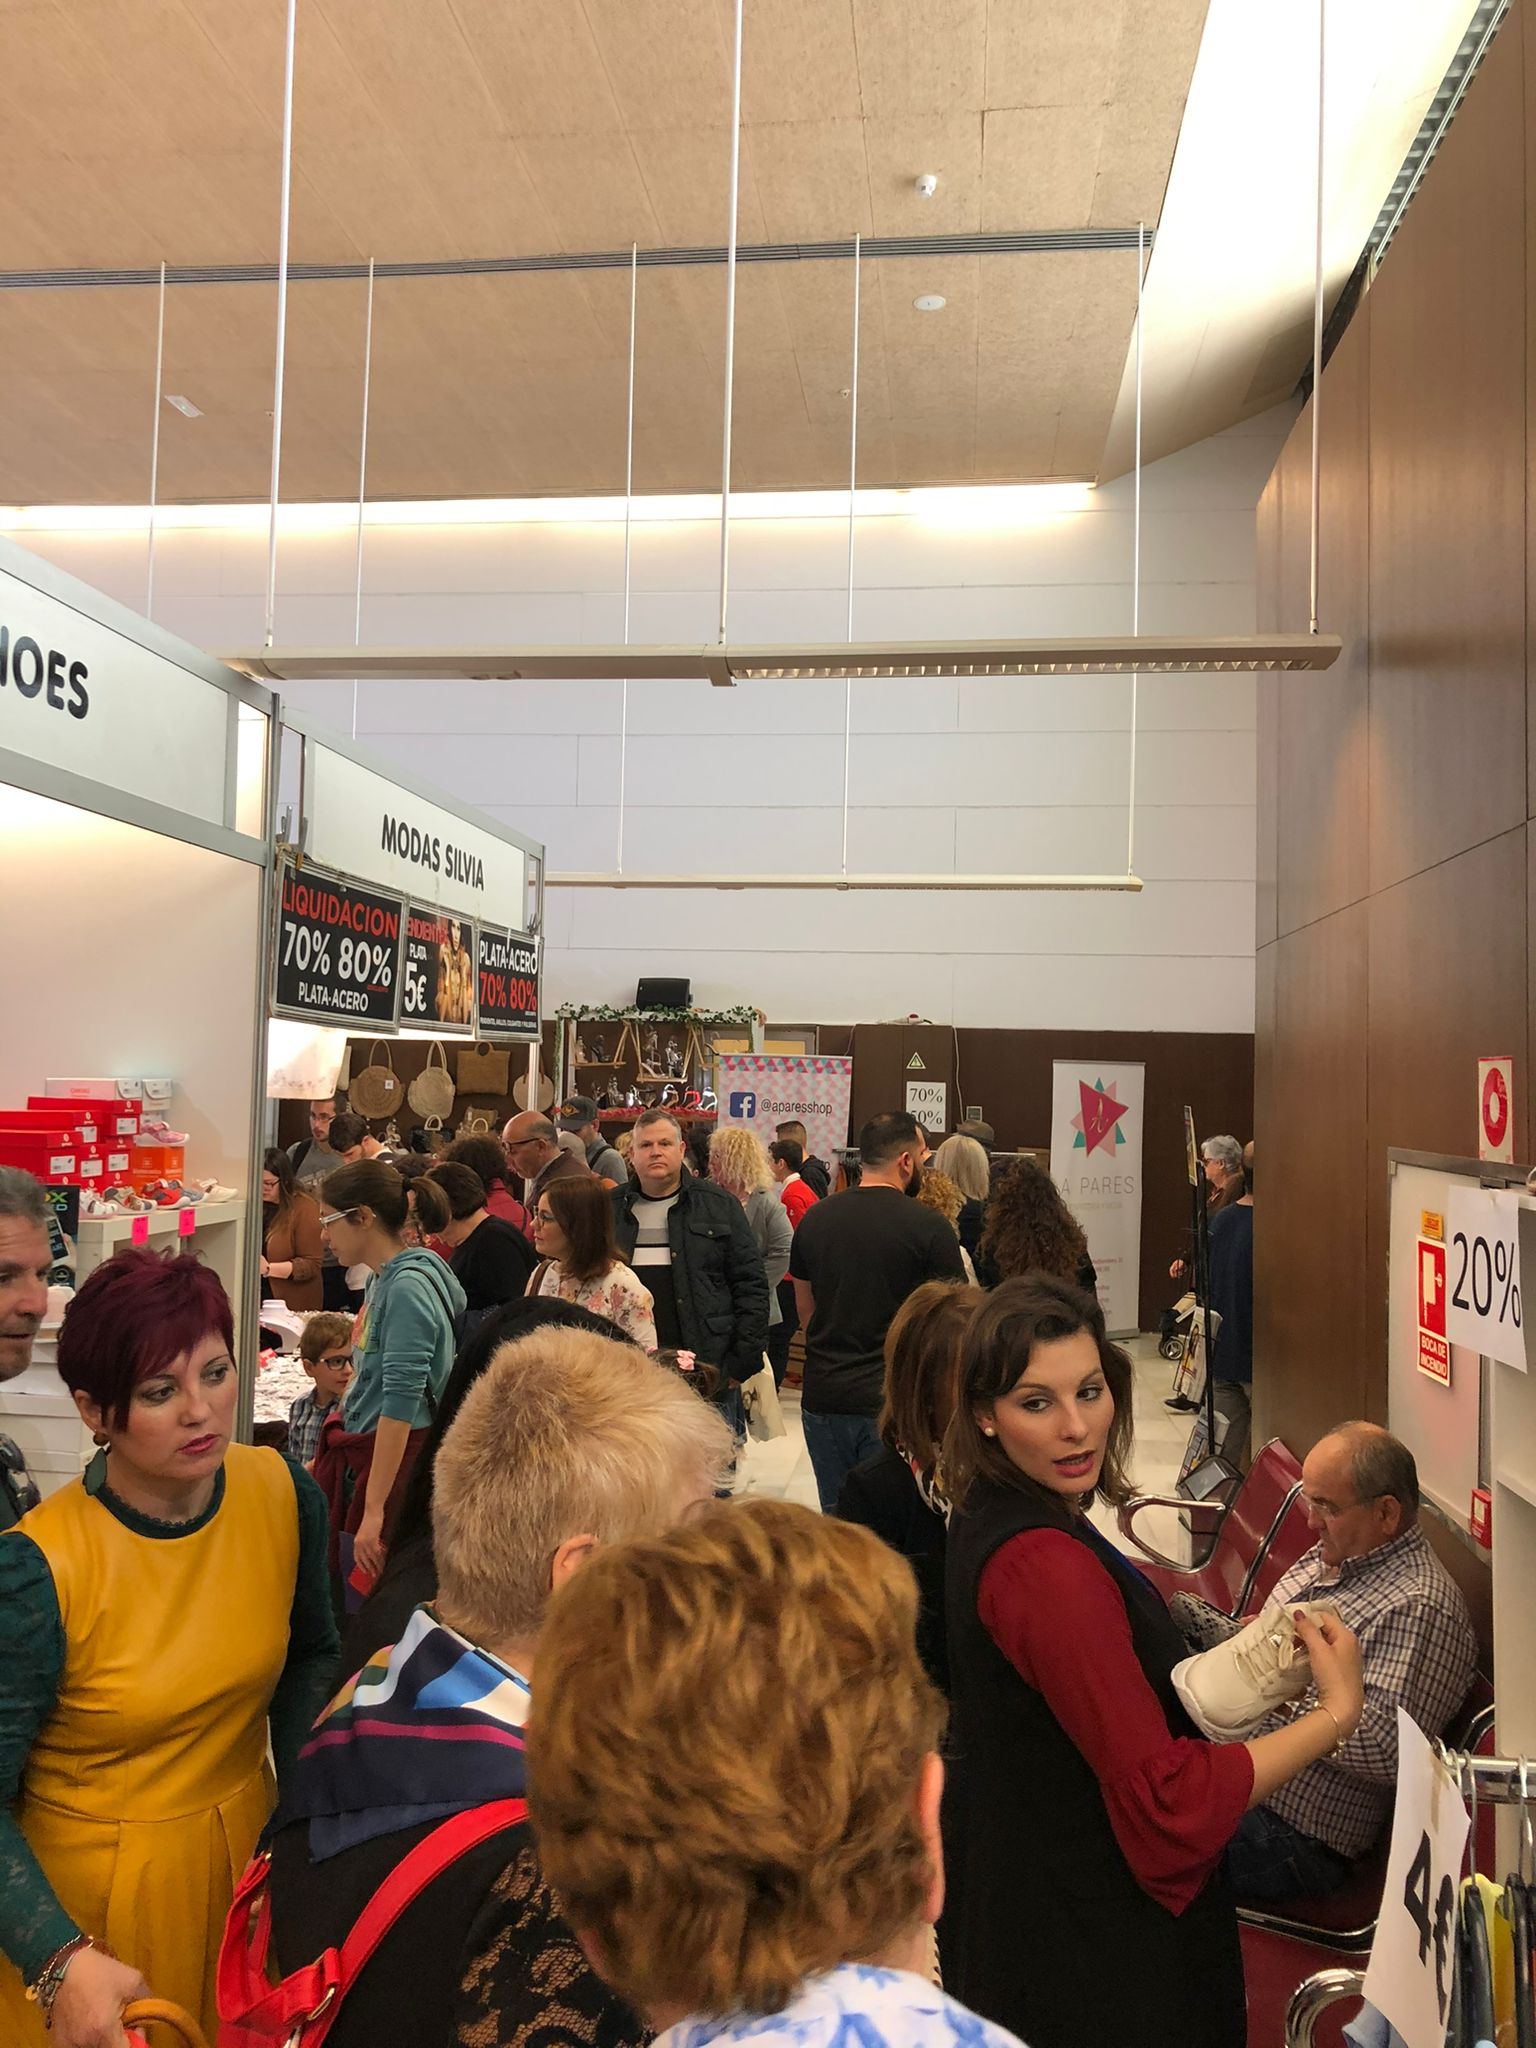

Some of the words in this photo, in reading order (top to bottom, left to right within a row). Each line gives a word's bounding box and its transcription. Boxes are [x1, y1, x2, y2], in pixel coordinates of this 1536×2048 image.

[381, 813, 440, 872] MODAS
[445, 843, 484, 891] SILVIA
[282, 879, 398, 940] LIQUIDACION
[283, 921, 331, 975] 70%
[338, 937, 392, 987] 80%
[409, 943, 427, 960] PLATA
[404, 961, 427, 1012] 5€
[480, 971, 506, 1008] 70%
[510, 977, 537, 1011] 80%
[761, 1098, 833, 1117] @aparesshop
[909, 1088, 943, 1103] 70%
[1060, 1178, 1071, 1195] A
[1080, 1176, 1135, 1194] PARES
[1452, 1232, 1521, 1328] 20%
[1421, 1335, 1438, 1355] BOCA
[1438, 1343, 1447, 1358] DE
[1420, 1352, 1447, 1377] INCENDIO
